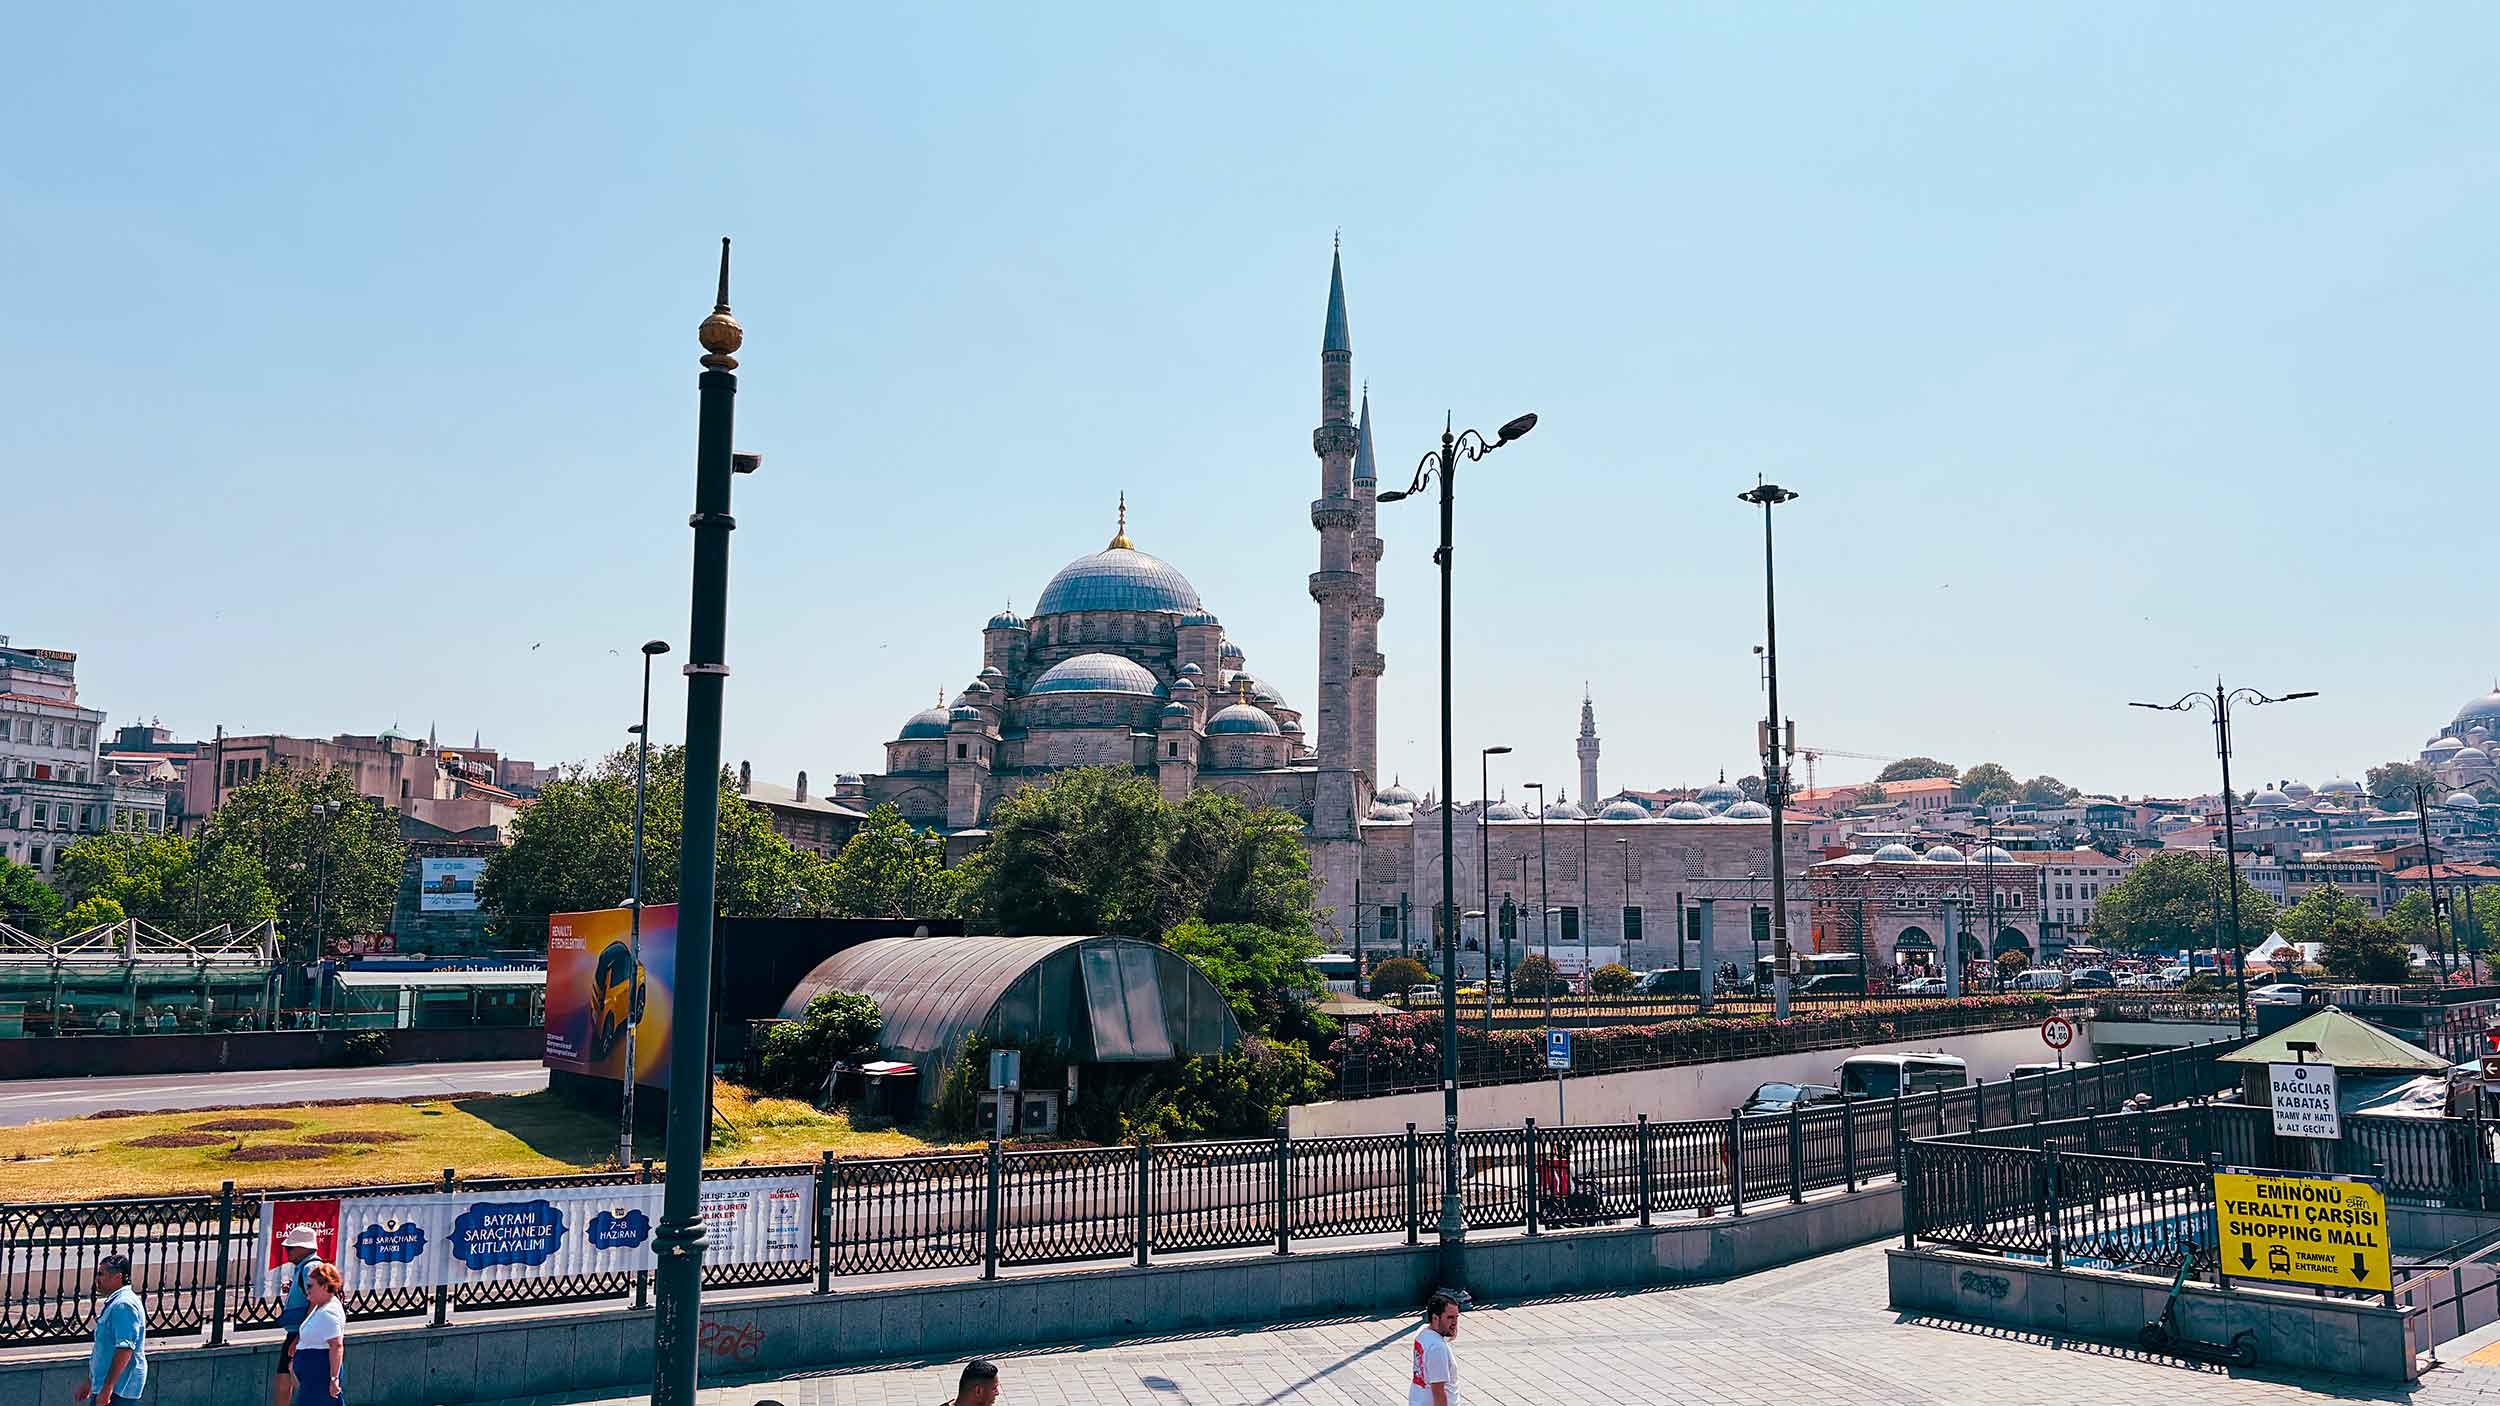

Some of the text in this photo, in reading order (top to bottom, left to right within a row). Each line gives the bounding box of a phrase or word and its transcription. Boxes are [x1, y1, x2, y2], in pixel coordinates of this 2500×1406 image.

[2326, 863, 2374, 871] RESTORAN
[482, 965, 540, 973] mutluluk
[2273, 1080, 2331, 1095] BAĞCILAR
[2277, 1096, 2329, 1112] KABATAŞ
[2315, 1113, 2334, 1122] HATTI
[2287, 1124, 2299, 1132] ALT
[2256, 1183, 2341, 1204] EMİNÖNÜ
[2225, 1200, 2379, 1227] YERALTI ÇARŞISI
[484, 1213, 535, 1227] BAYRAMI
[610, 1221, 627, 1230] 7-8
[2230, 1221, 2378, 1248] SHOPPING MALL
[2296, 1252, 2336, 1263] TRAMWAY
[2296, 1264, 2339, 1274] ENTRANCE
